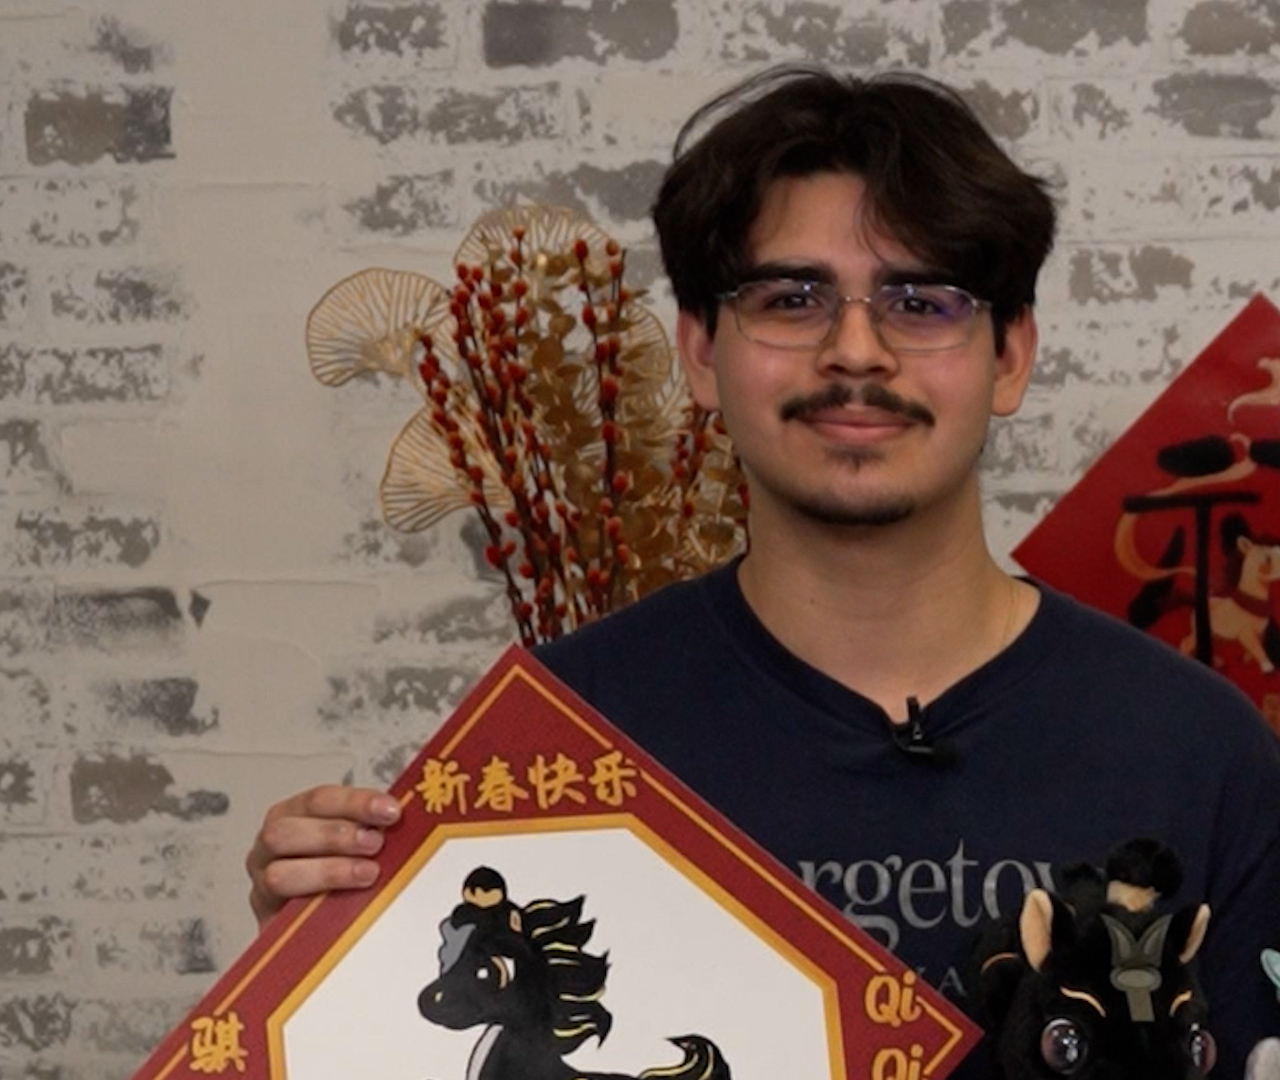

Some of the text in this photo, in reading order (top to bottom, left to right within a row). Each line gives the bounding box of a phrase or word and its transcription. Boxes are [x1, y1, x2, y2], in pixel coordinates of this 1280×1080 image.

[415, 750, 639, 813] 新春快乐
[865, 972, 920, 1026] Qi
